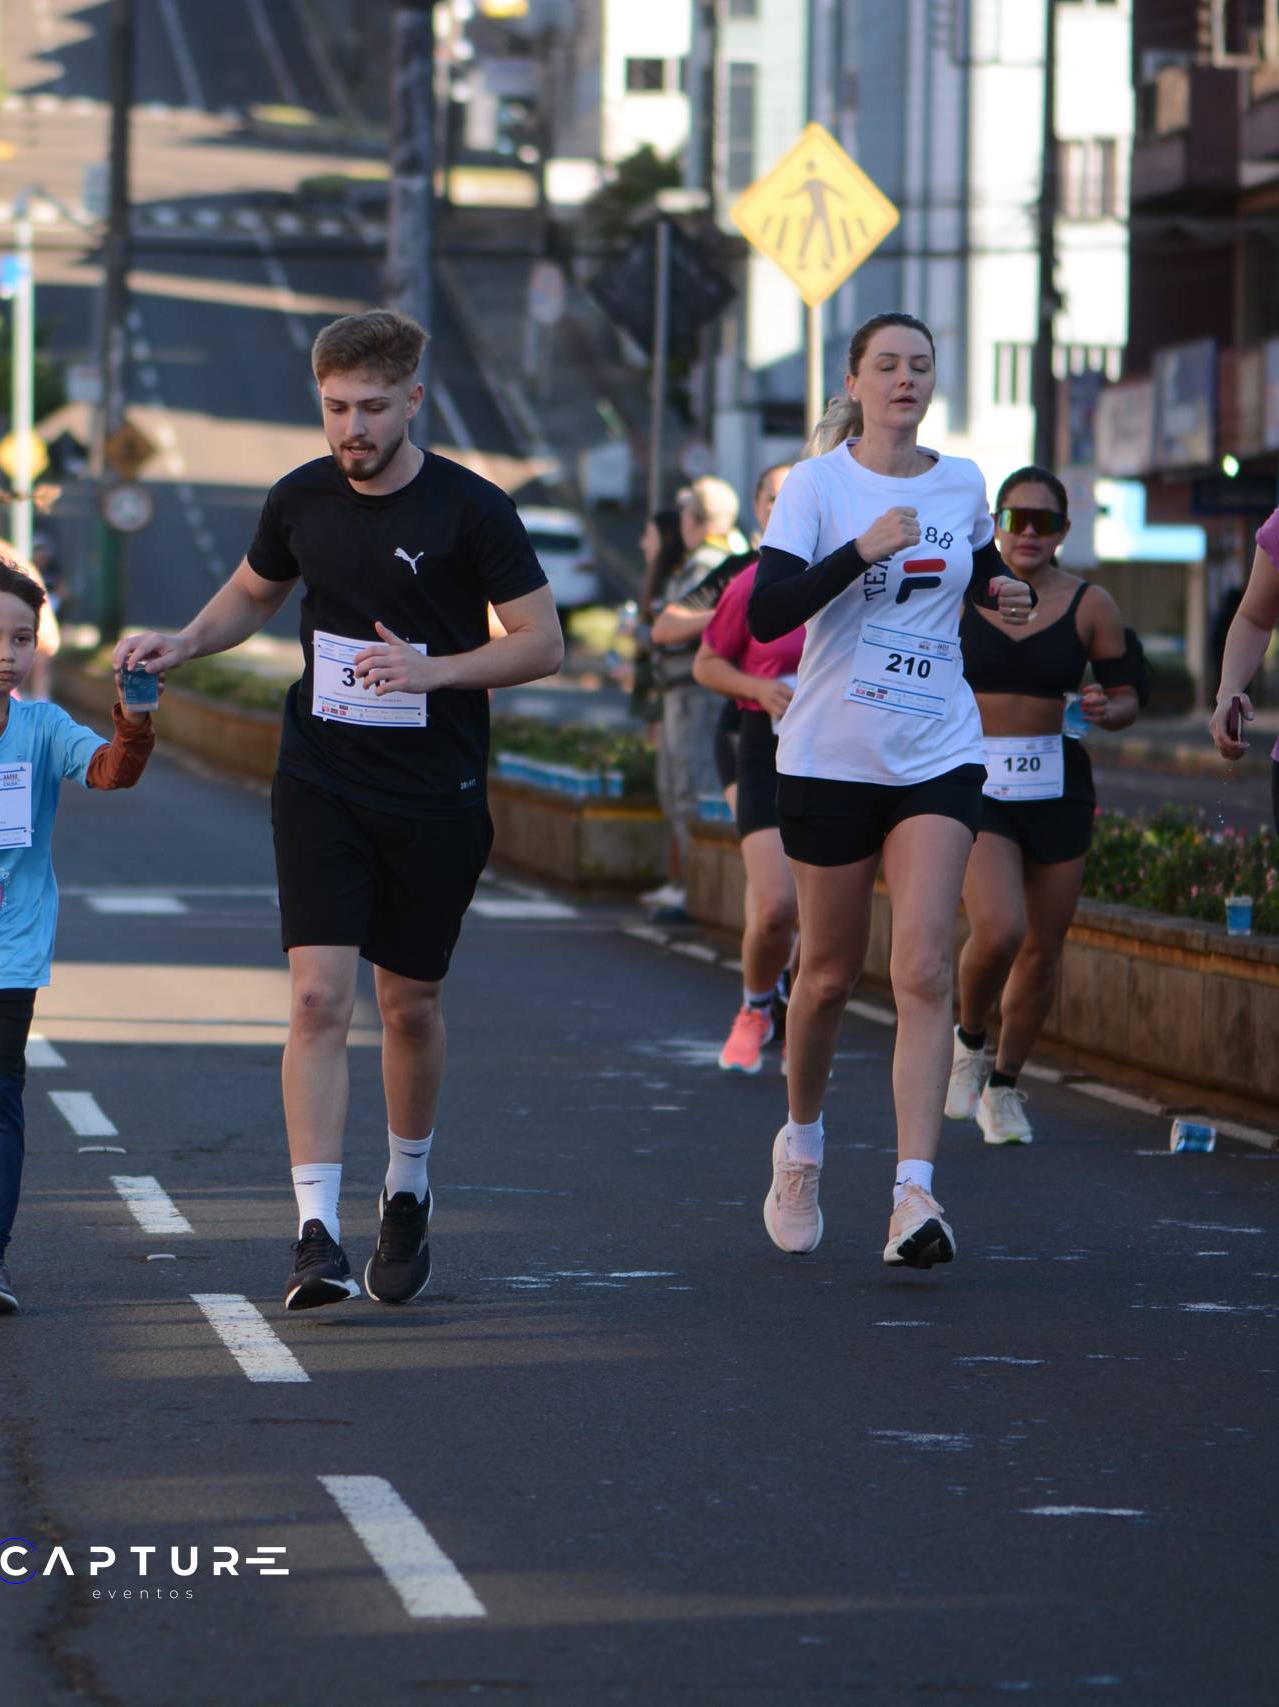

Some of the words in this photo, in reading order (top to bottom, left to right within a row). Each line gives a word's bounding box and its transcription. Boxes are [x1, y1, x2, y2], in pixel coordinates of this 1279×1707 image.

[925, 526, 954, 550] 88
[863, 553, 894, 602] TEA
[885, 653, 931, 679] 210
[1003, 757, 1041, 773] 120
